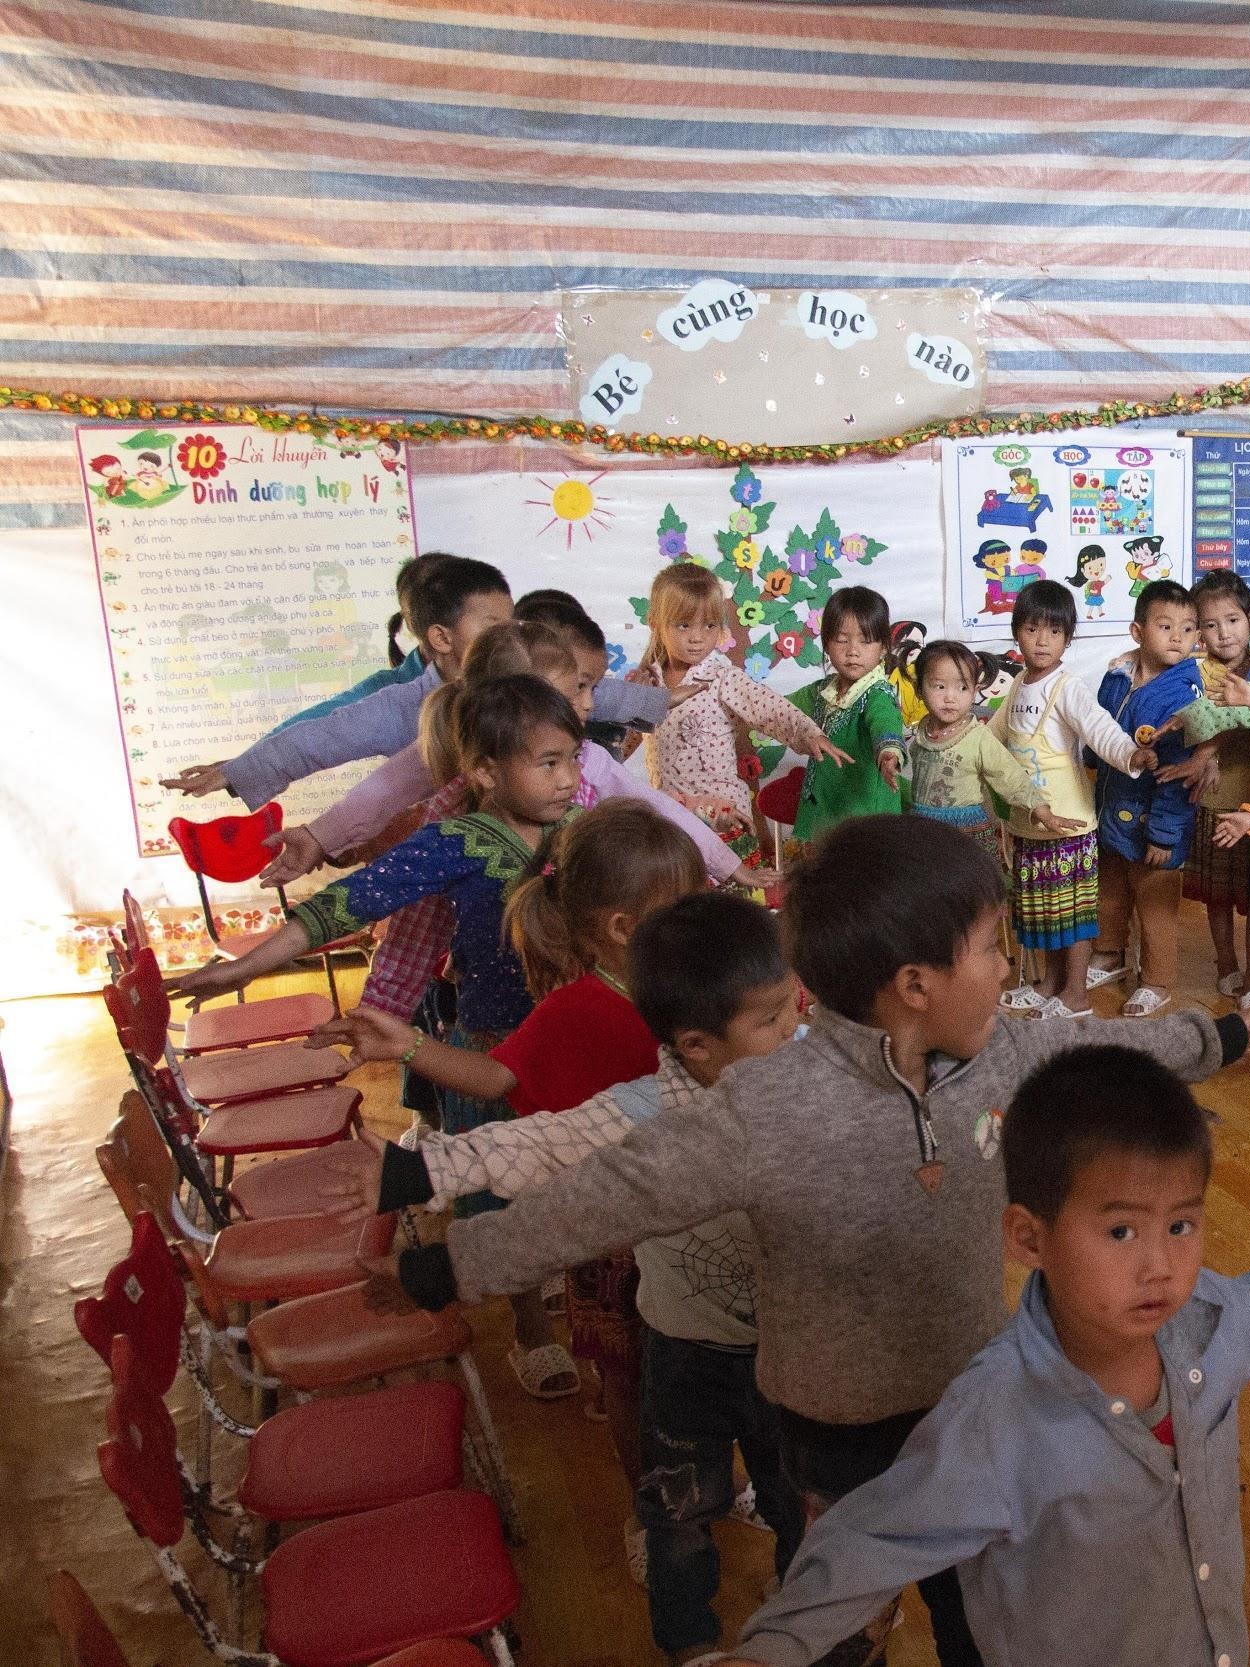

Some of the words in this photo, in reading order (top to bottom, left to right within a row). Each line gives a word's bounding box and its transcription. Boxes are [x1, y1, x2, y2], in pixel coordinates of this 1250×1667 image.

[591, 368, 639, 415] Bé
[672, 290, 754, 339] cùng
[808, 295, 866, 337] học
[913, 339, 971, 384] nào
[188, 445, 218, 469] 10
[228, 435, 264, 465] Lời
[273, 437, 328, 469] khuyên
[1001, 449, 1022, 460] GÓC
[1063, 451, 1083, 462] HỌC
[1126, 451, 1145, 462] TẬP
[192, 480, 238, 505] Dinh
[316, 475, 352, 505] hợp
[363, 474, 380, 503] lý
[824, 541, 835, 560] k
[744, 606, 757, 620] c
[783, 636, 796, 654] q
